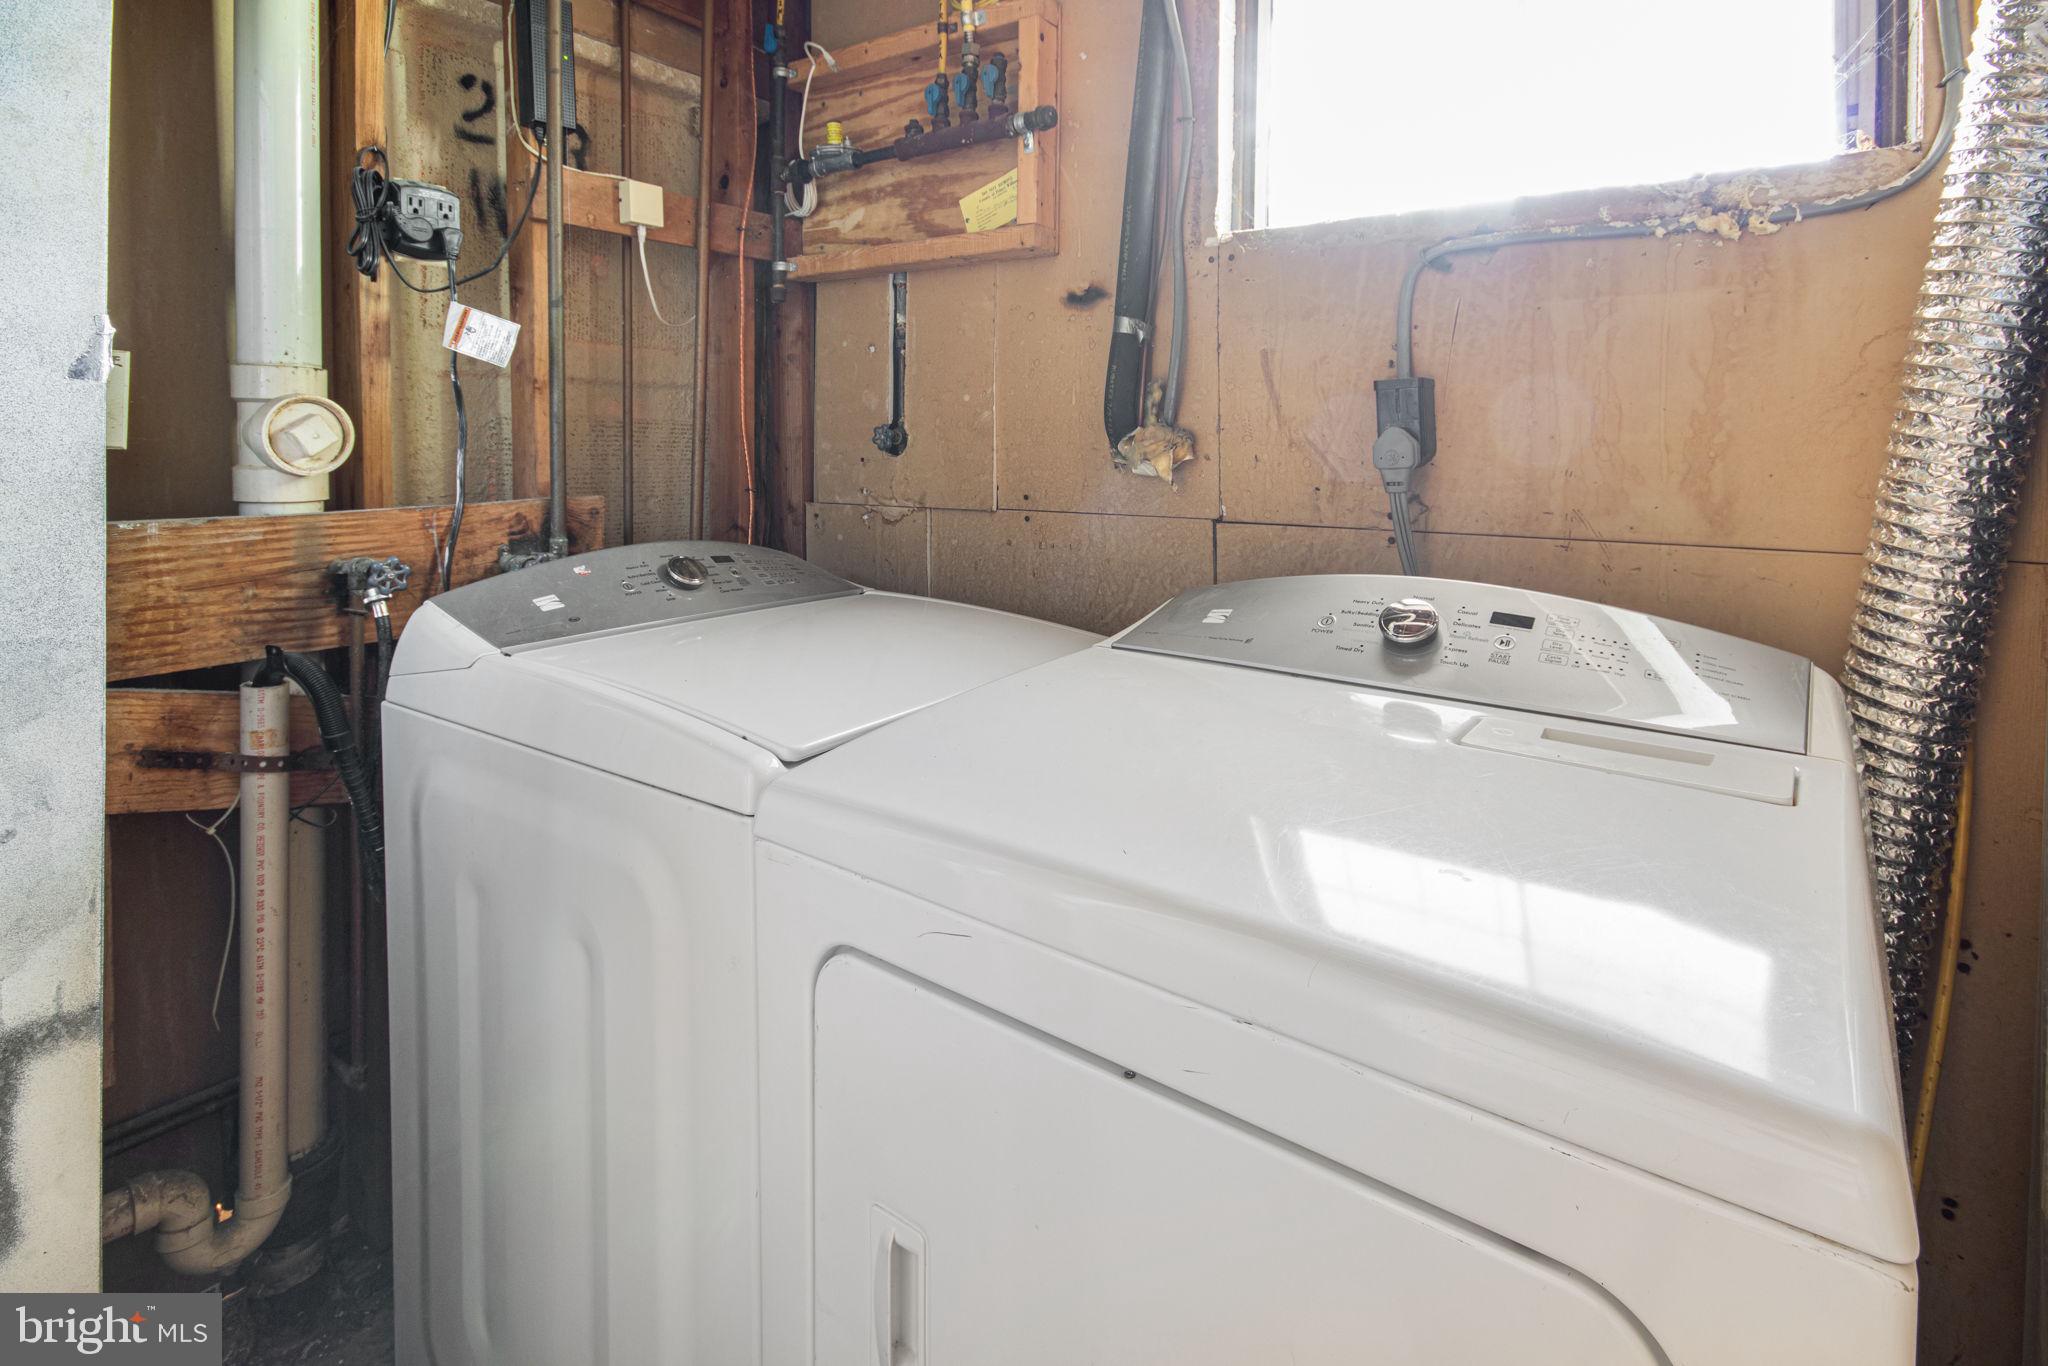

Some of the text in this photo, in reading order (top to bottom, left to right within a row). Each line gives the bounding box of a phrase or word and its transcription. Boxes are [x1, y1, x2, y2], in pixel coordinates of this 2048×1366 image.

[1452, 621, 1481, 629] Delicates
[1444, 646, 1468, 654] Express
[1490, 652, 1512, 660] START
[1440, 658, 1458, 666] Touch
[1488, 658, 1510, 666] PAUSE
